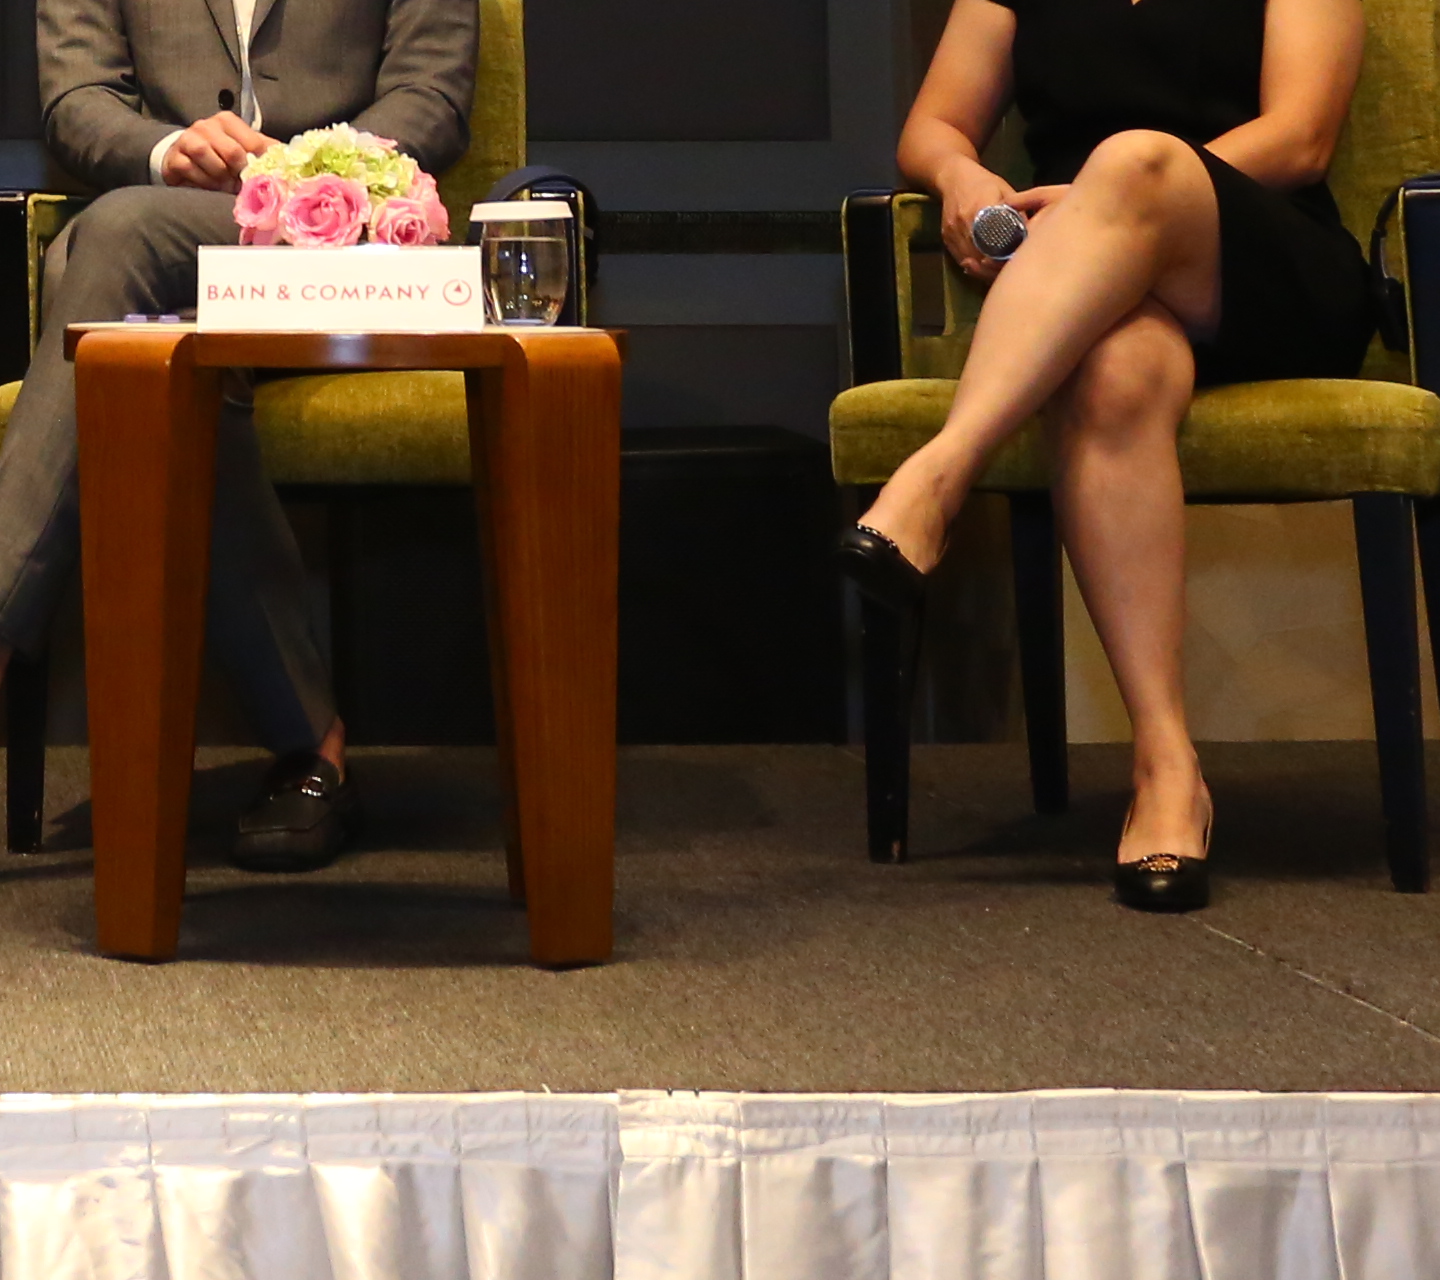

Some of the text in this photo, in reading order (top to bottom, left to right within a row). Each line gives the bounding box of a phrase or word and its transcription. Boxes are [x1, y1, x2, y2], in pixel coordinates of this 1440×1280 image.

[206, 282, 431, 302] BAIN & COMPANY
